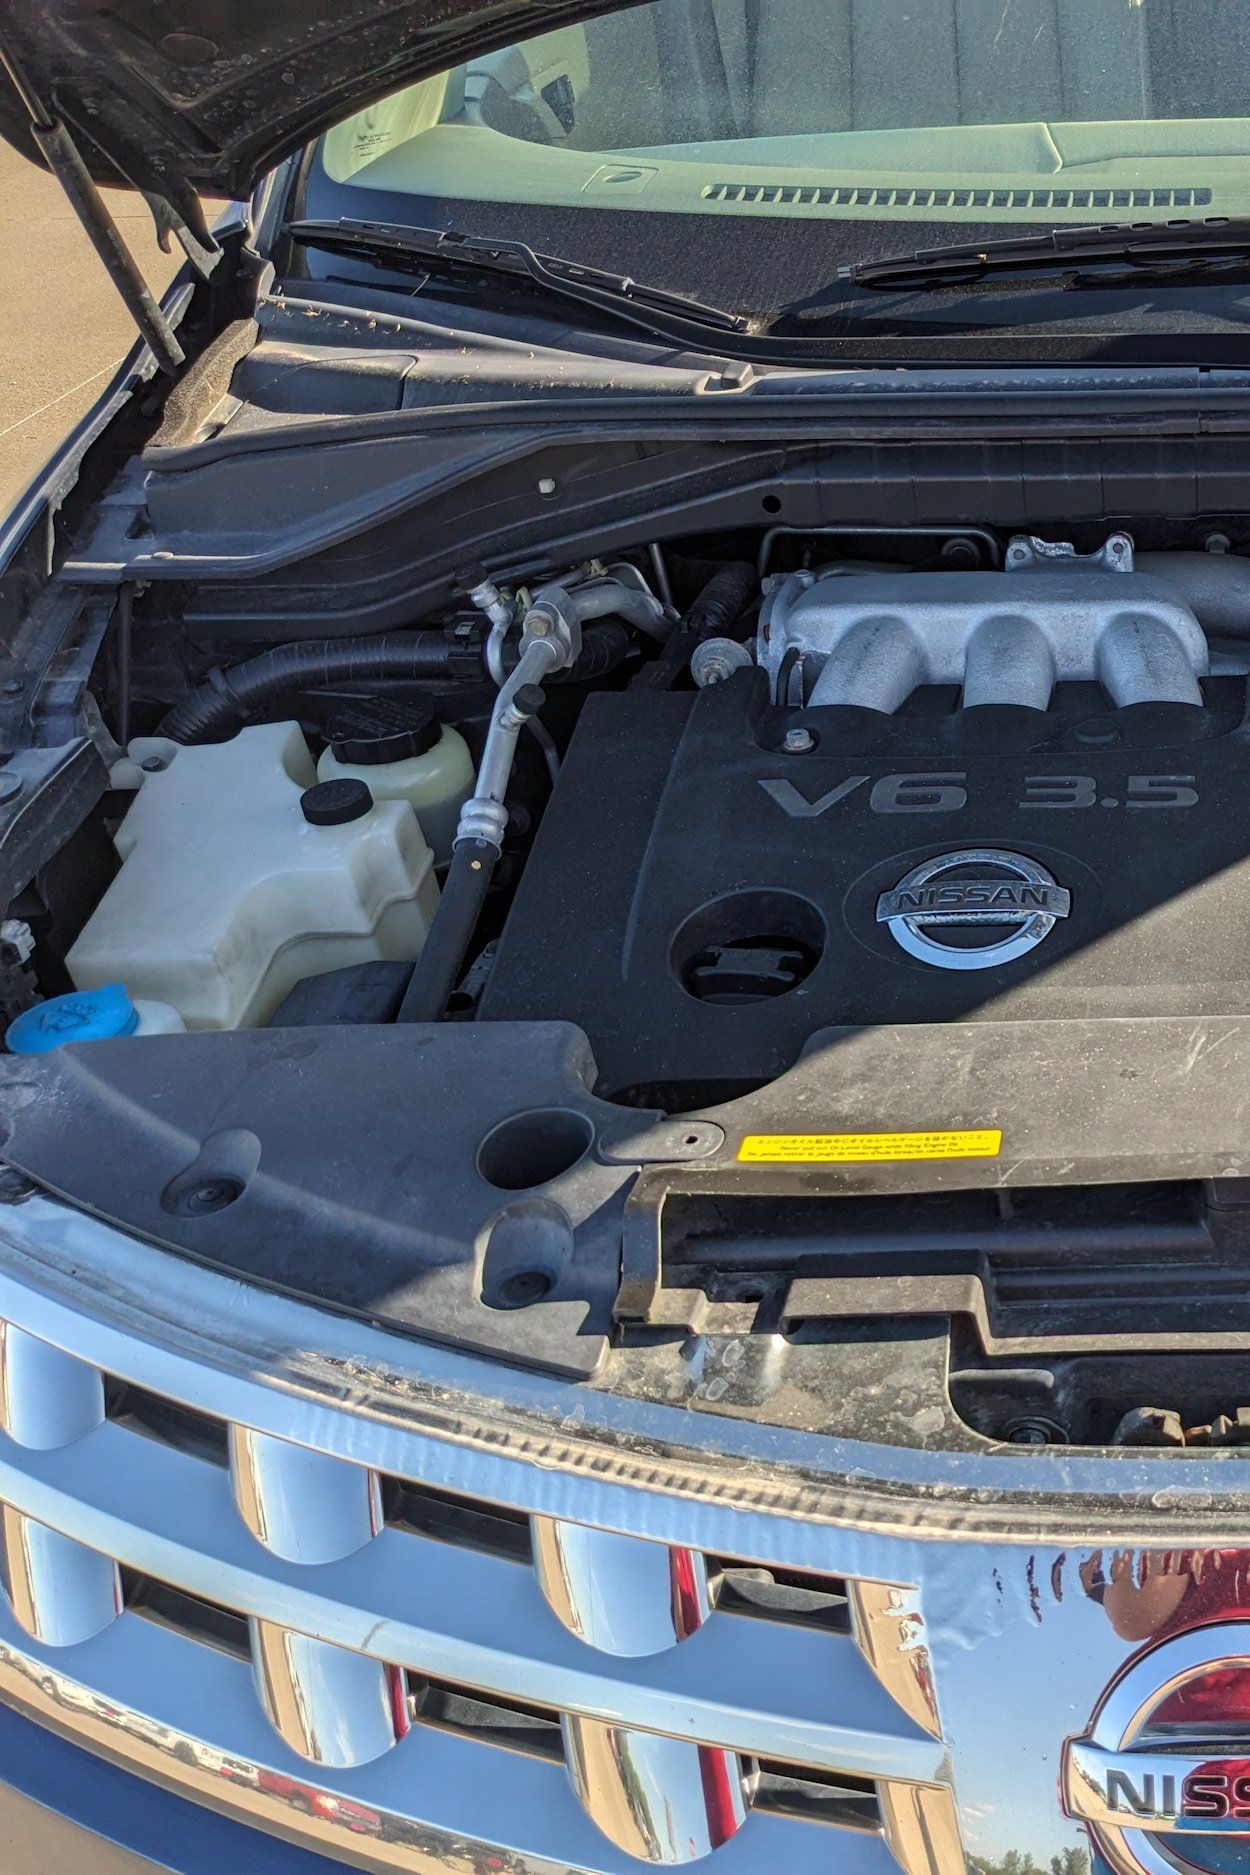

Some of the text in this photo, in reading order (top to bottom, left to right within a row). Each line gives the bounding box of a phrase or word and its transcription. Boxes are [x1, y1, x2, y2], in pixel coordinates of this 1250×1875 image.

[757, 771, 1199, 818] V6 3.5
[898, 885, 1049, 909] NISSAN
